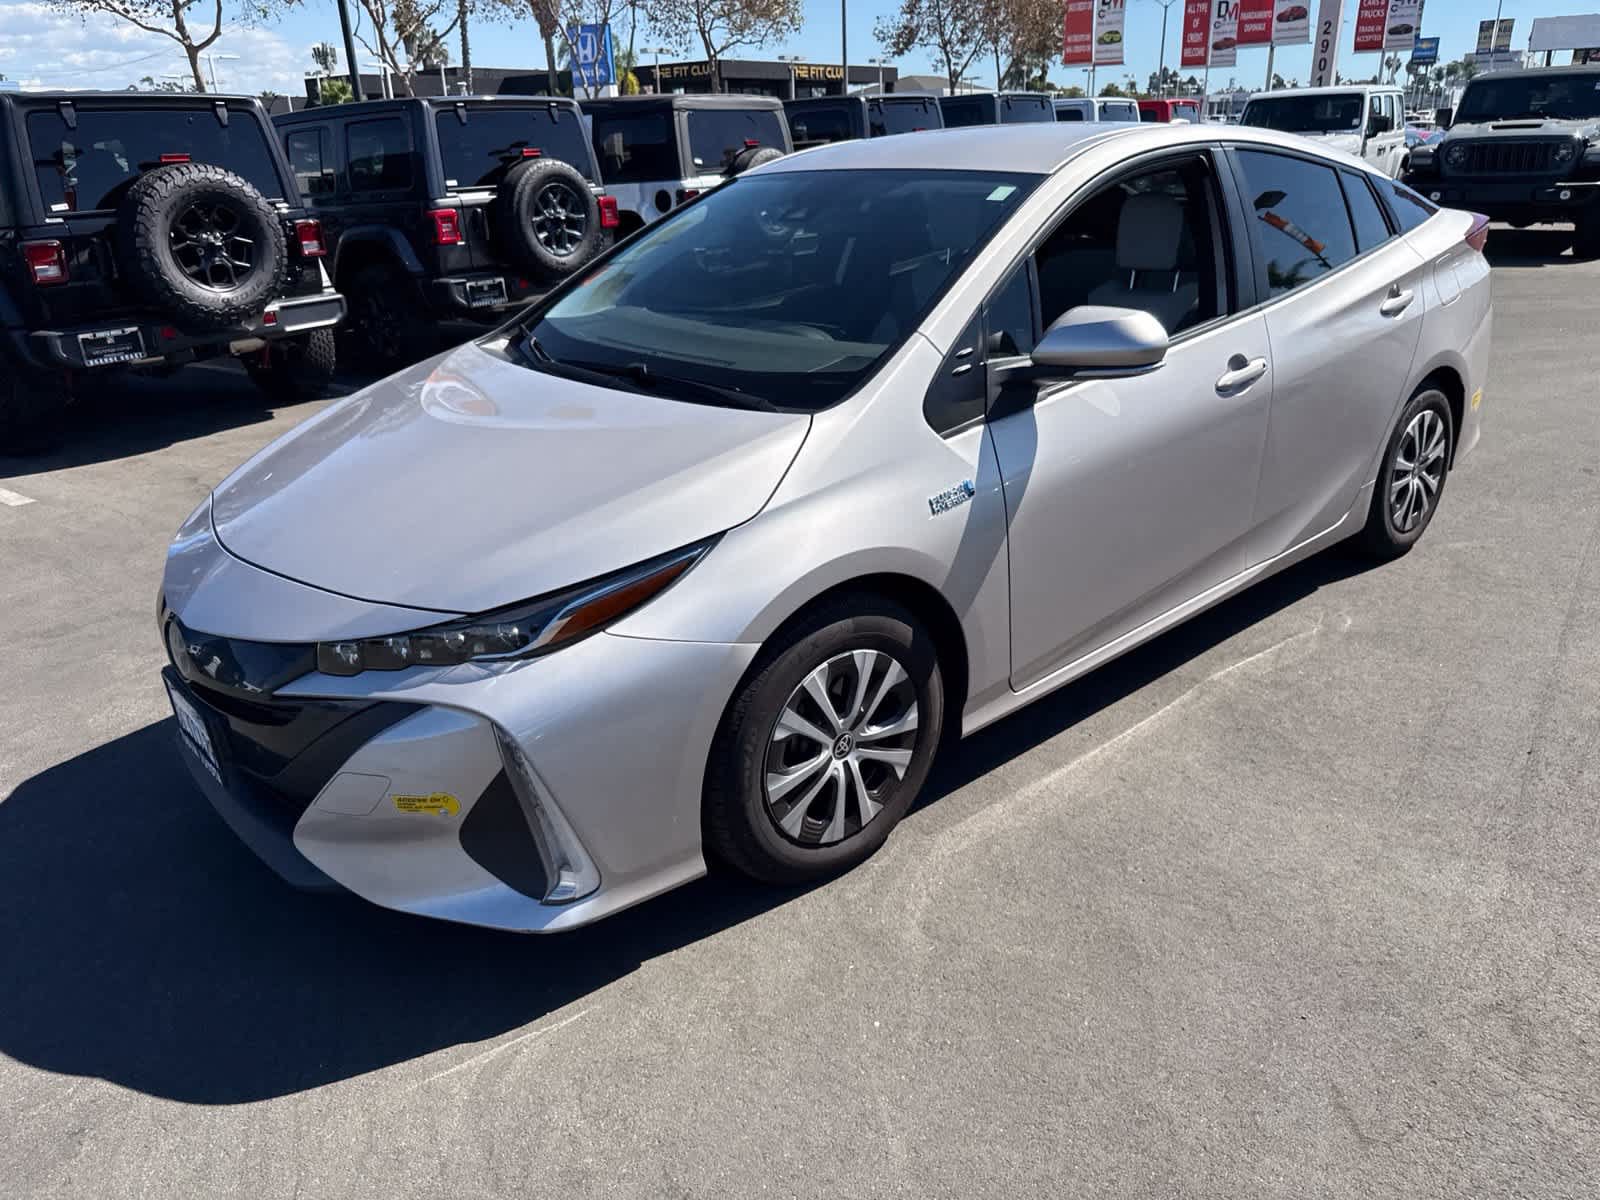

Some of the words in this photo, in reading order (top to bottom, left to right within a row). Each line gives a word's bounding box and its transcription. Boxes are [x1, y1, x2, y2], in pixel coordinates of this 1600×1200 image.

[1360, 8, 1385, 18] TRUCKS
[1192, 17, 1200, 29] OF
[1316, 20, 1333, 87] 2901
[673, 65, 689, 77] FIT
[810, 66, 825, 79] FIT
